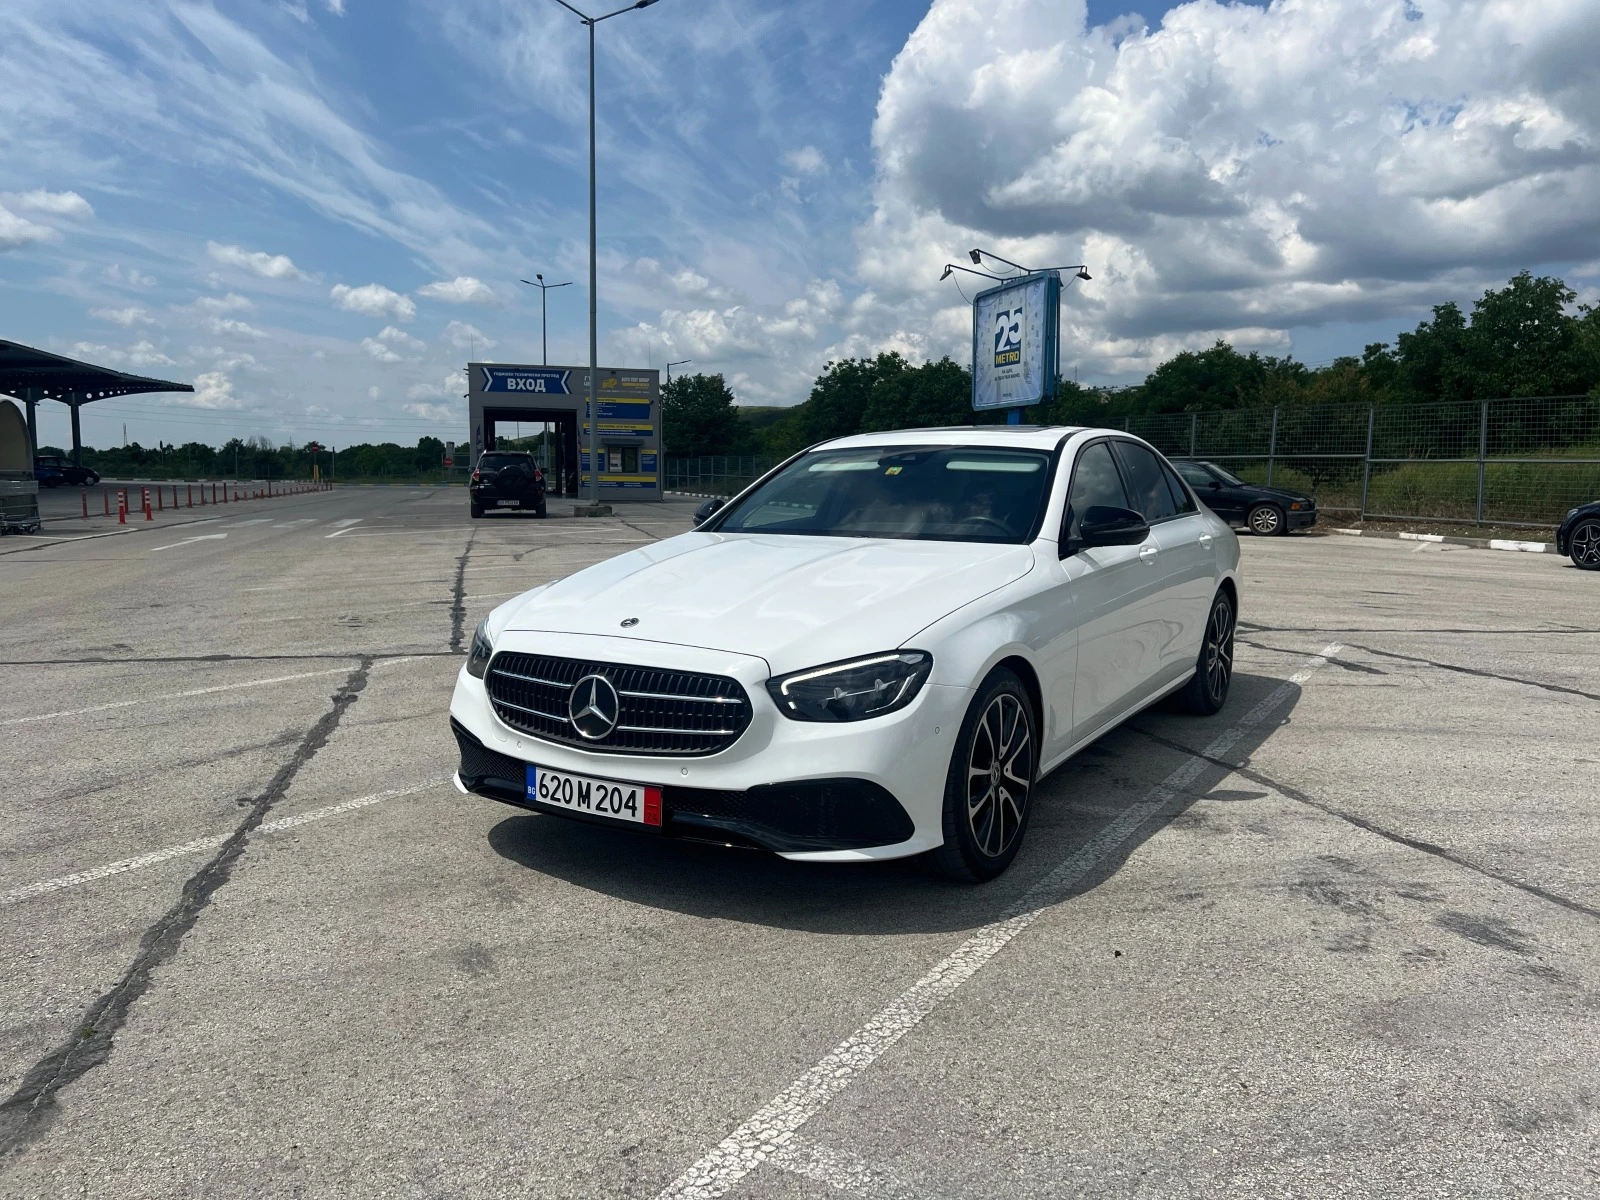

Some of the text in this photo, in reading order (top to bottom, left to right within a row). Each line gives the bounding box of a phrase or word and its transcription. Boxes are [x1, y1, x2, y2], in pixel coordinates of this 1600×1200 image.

[995, 307, 1023, 352] 25
[995, 350, 1020, 365] METRO
[507, 378, 546, 393] ВХОД
[527, 785, 536, 795] BG
